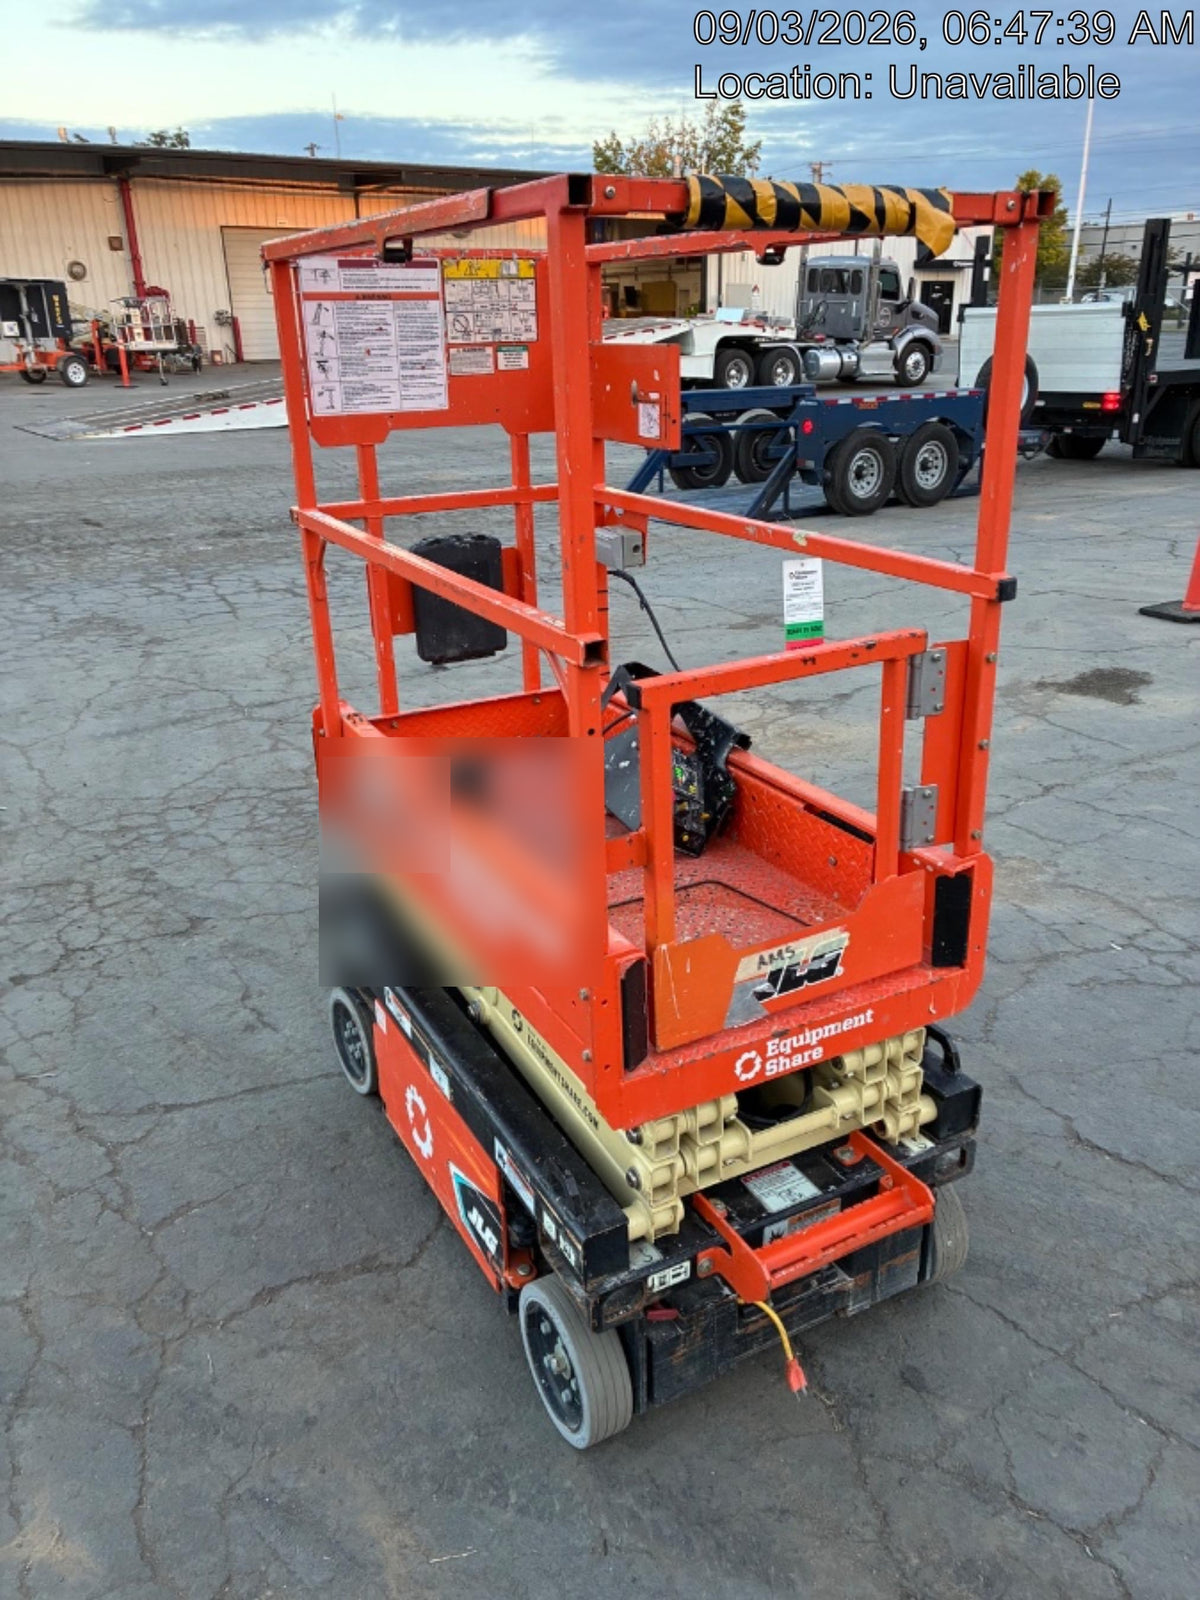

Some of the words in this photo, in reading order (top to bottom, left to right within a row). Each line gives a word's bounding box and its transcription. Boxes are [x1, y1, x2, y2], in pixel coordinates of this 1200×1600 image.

[756, 944, 796, 970] AMS
[765, 1008, 874, 1058] Equipment
[764, 1045, 824, 1076] Share
[467, 1205, 499, 1256] JLG
